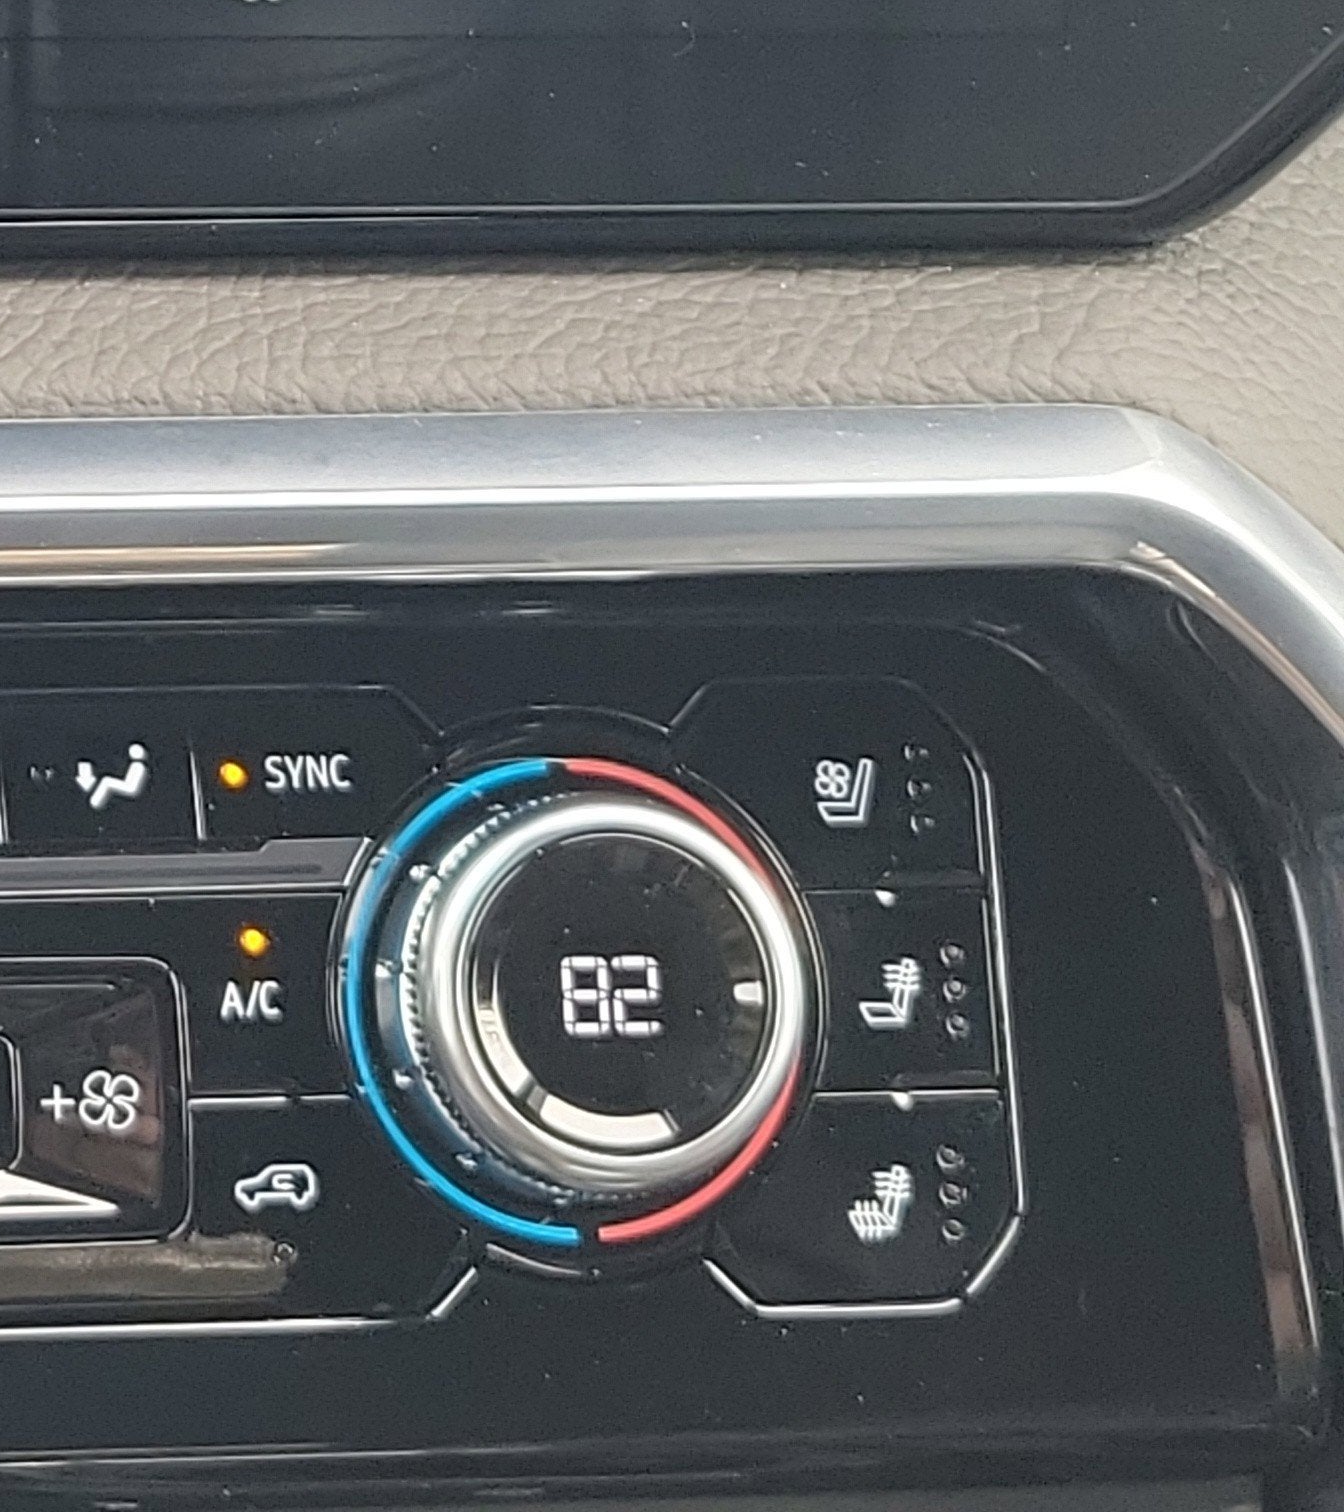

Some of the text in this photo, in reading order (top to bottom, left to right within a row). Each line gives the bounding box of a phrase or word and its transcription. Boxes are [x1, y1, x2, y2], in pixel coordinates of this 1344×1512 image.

[264, 755, 351, 790] SYNC
[221, 985, 282, 1020] A/C
[559, 954, 664, 1037] 82
